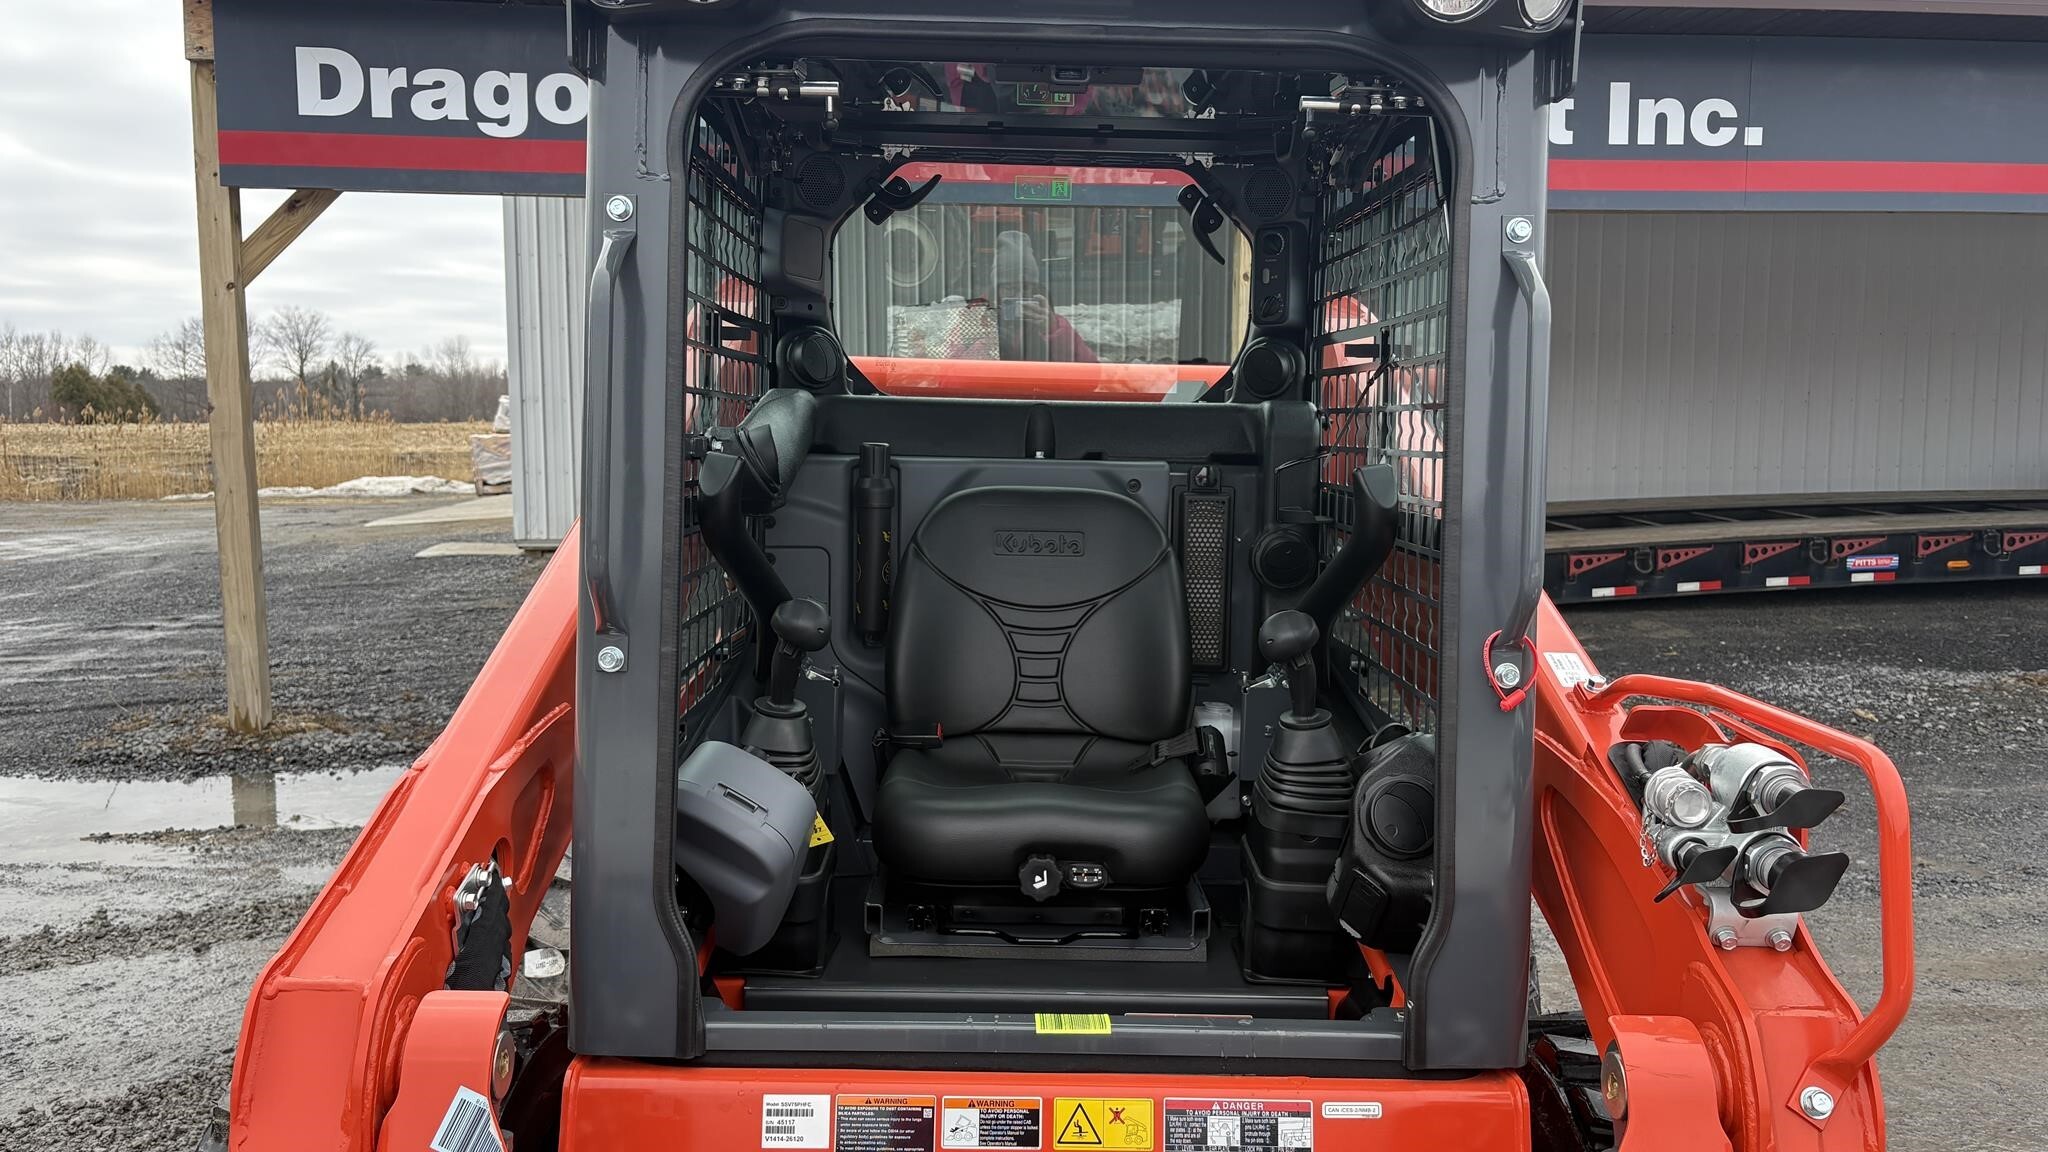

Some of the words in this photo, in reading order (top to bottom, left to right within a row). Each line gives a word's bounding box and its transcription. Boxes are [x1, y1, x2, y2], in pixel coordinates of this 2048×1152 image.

[1609, 82, 1764, 147] Inc.
[995, 533, 1081, 554] Kubota
[1222, 1102, 1264, 1110] DANGER
